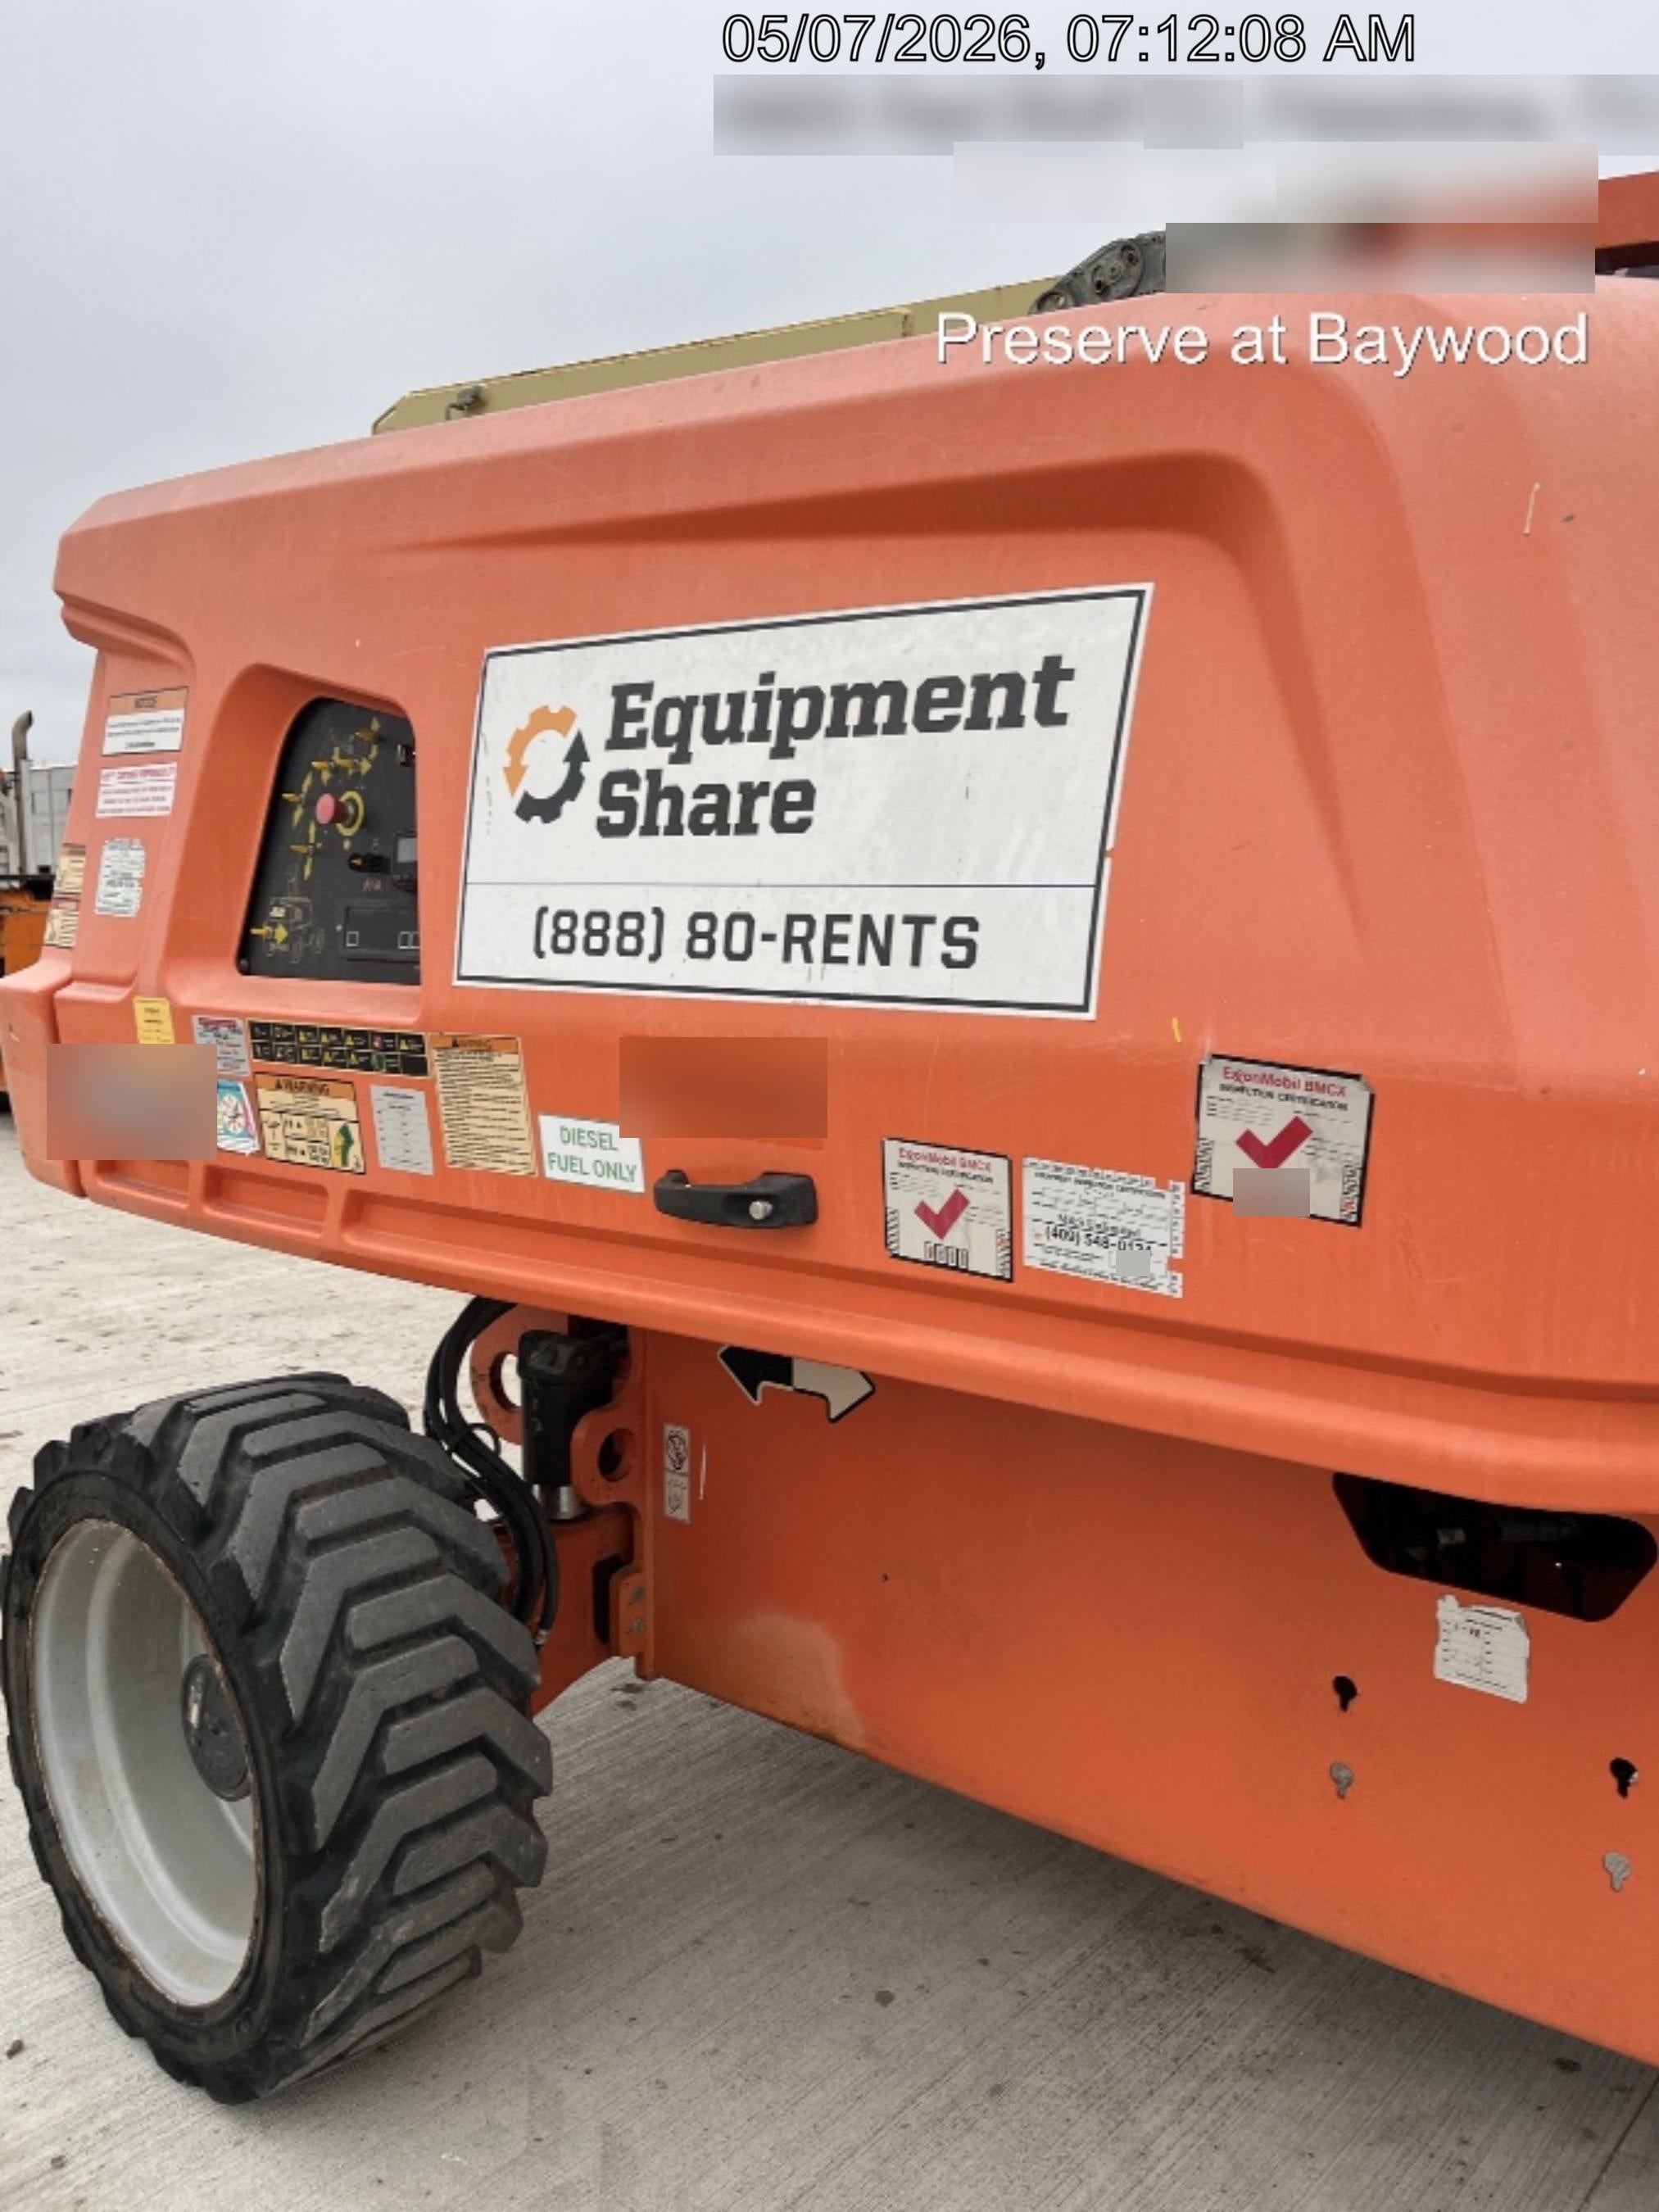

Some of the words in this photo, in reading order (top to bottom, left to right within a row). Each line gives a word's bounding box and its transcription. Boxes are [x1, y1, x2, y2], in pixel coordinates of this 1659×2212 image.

[605, 655, 1075, 764] Equipment
[596, 768, 817, 838] Share
[533, 906, 665, 963] (888)
[686, 912, 980, 969] 80-RENTS
[547, 1152, 590, 1176] FUEL
[592, 1159, 637, 1182] ONLY
[560, 1126, 619, 1151] DIESEL
